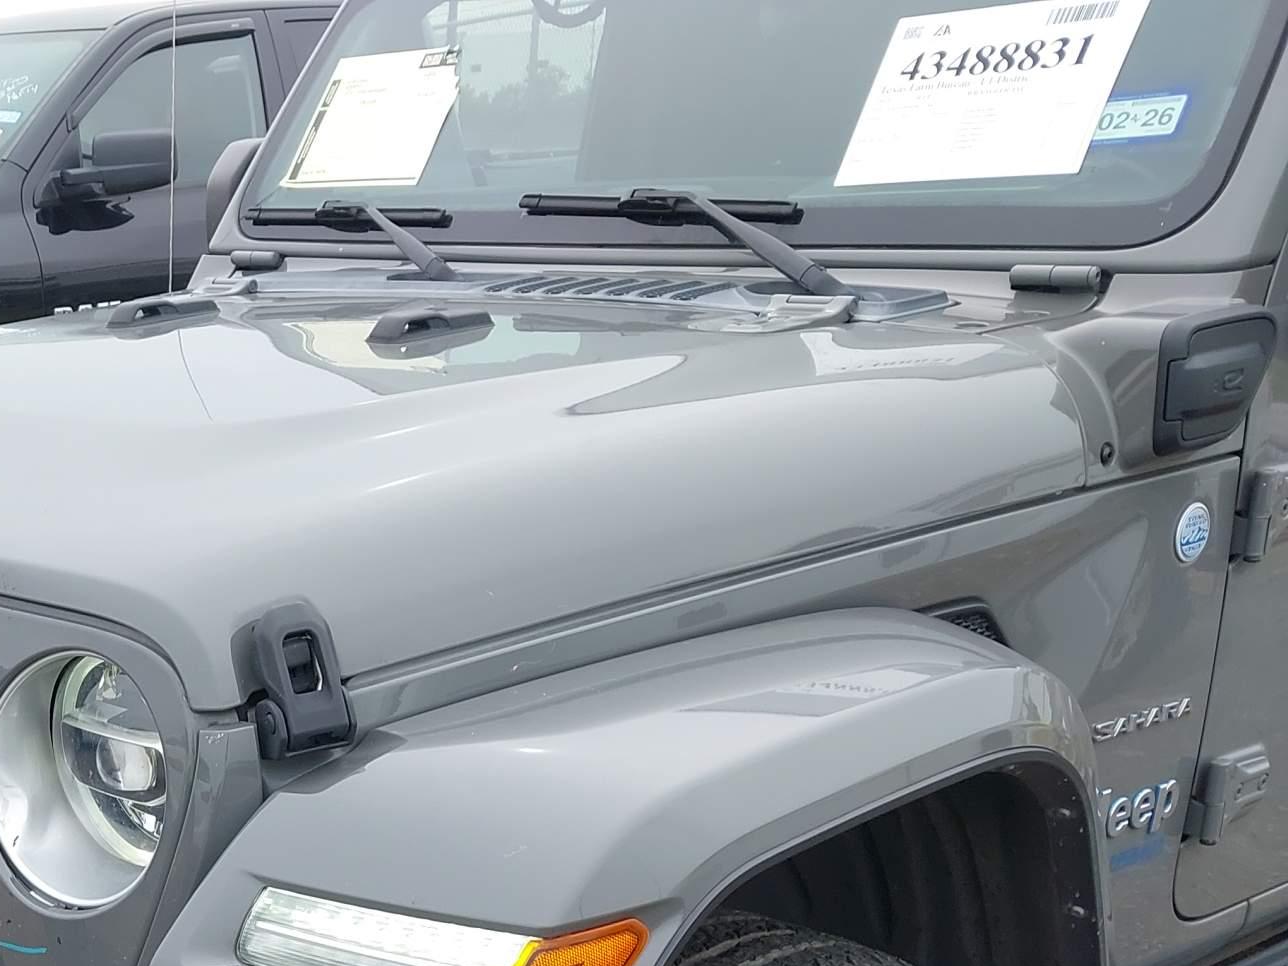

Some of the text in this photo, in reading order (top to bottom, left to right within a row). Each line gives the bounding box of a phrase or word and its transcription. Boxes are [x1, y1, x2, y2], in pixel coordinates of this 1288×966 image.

[900, 33, 1095, 80] 43488831
[1098, 107, 1175, 131] 02 26
[1092, 697, 1191, 742] SAHARA
